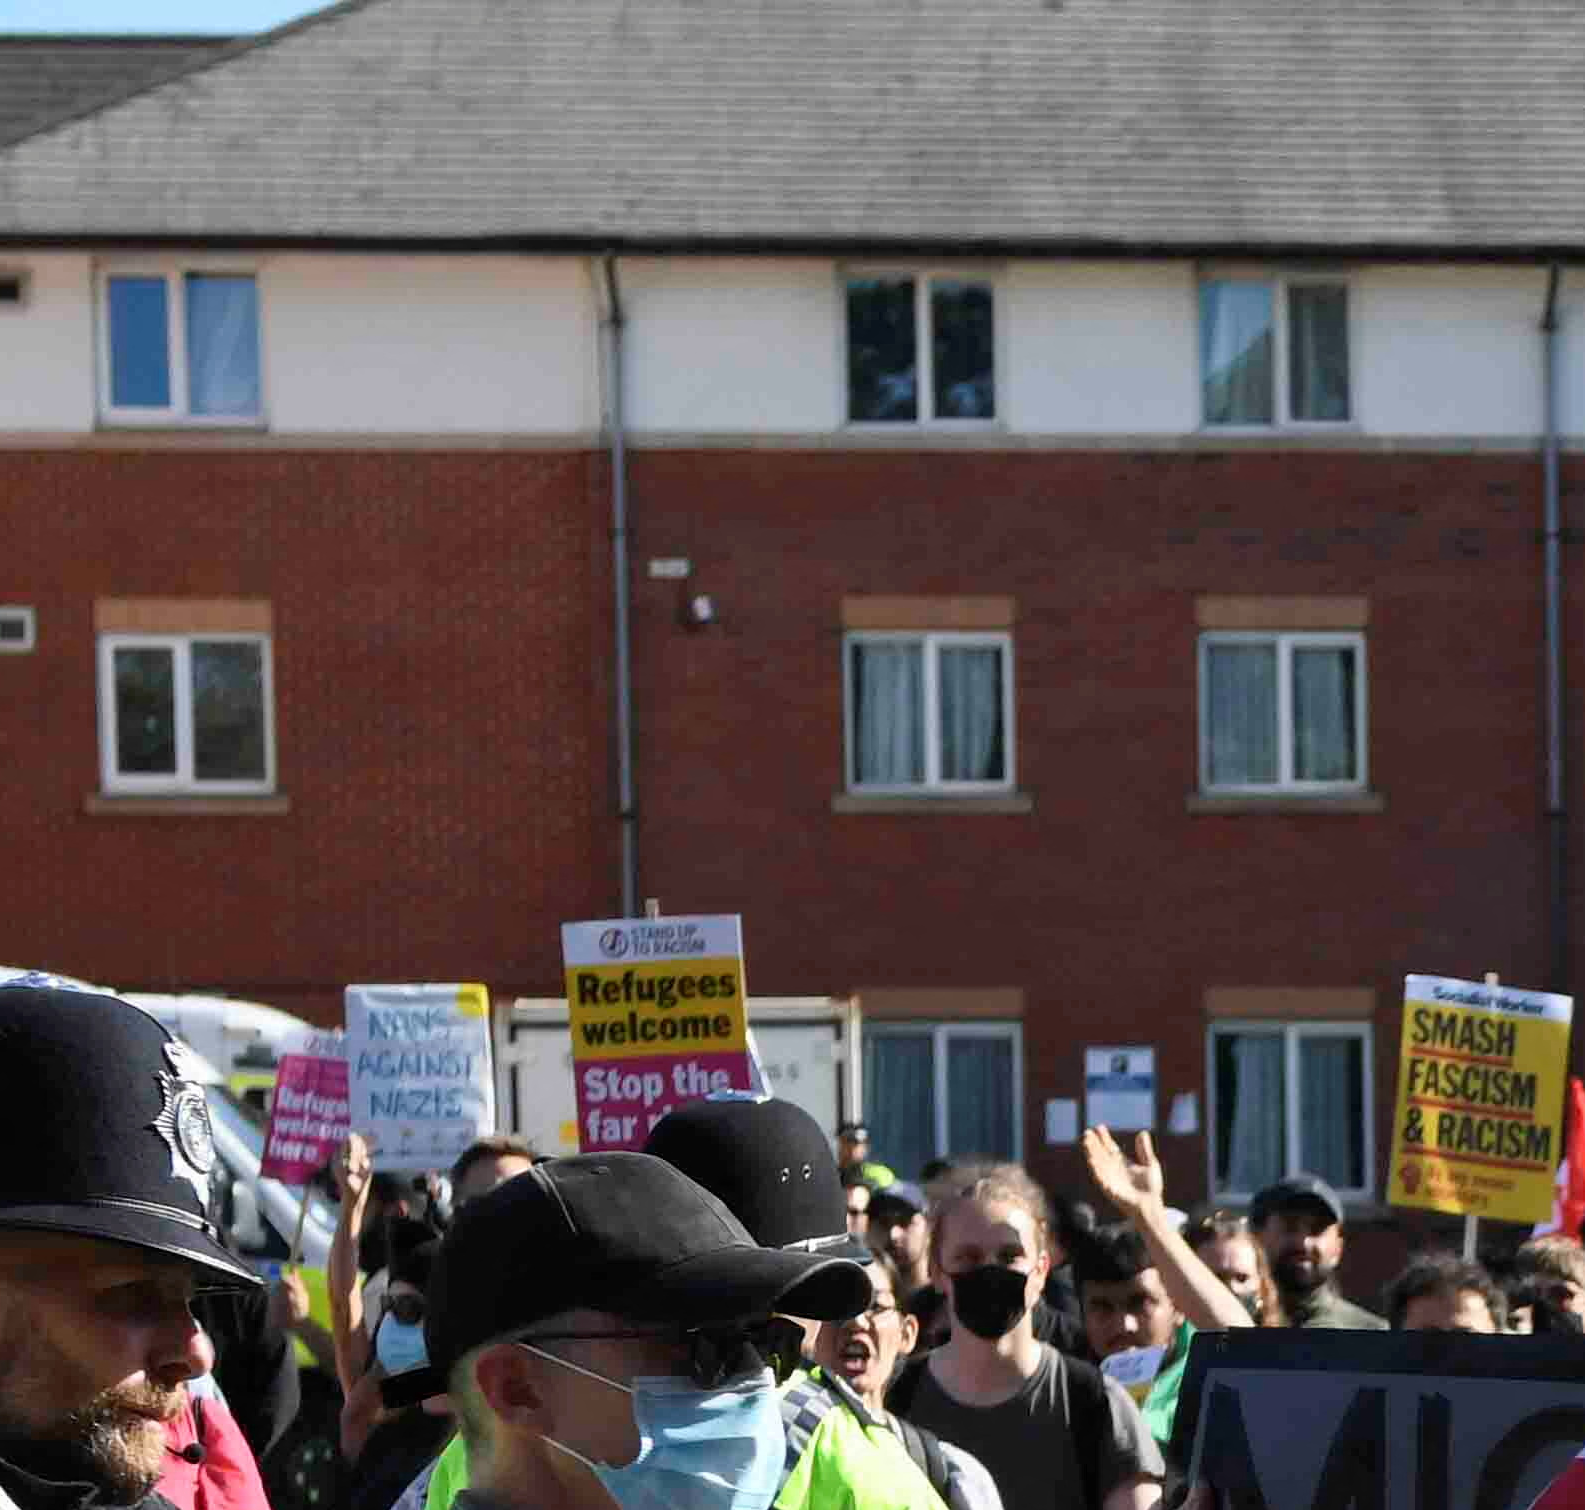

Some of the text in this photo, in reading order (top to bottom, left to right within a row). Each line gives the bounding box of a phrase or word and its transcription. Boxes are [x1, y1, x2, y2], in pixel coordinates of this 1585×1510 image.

[576, 969, 736, 1008] Refugees
[581, 1012, 732, 1047] welcome
[1411, 1007, 1516, 1056] SMASH
[356, 1053, 472, 1080] AGAINST
[584, 1068, 663, 1106] Stop
[673, 1060, 730, 1095] the
[1408, 1058, 1537, 1109] FASCISM
[370, 1089, 462, 1118] NAZIS
[586, 1108, 638, 1144] far
[1404, 1107, 1552, 1162] & RACISM
[268, 1135, 319, 1162] here
